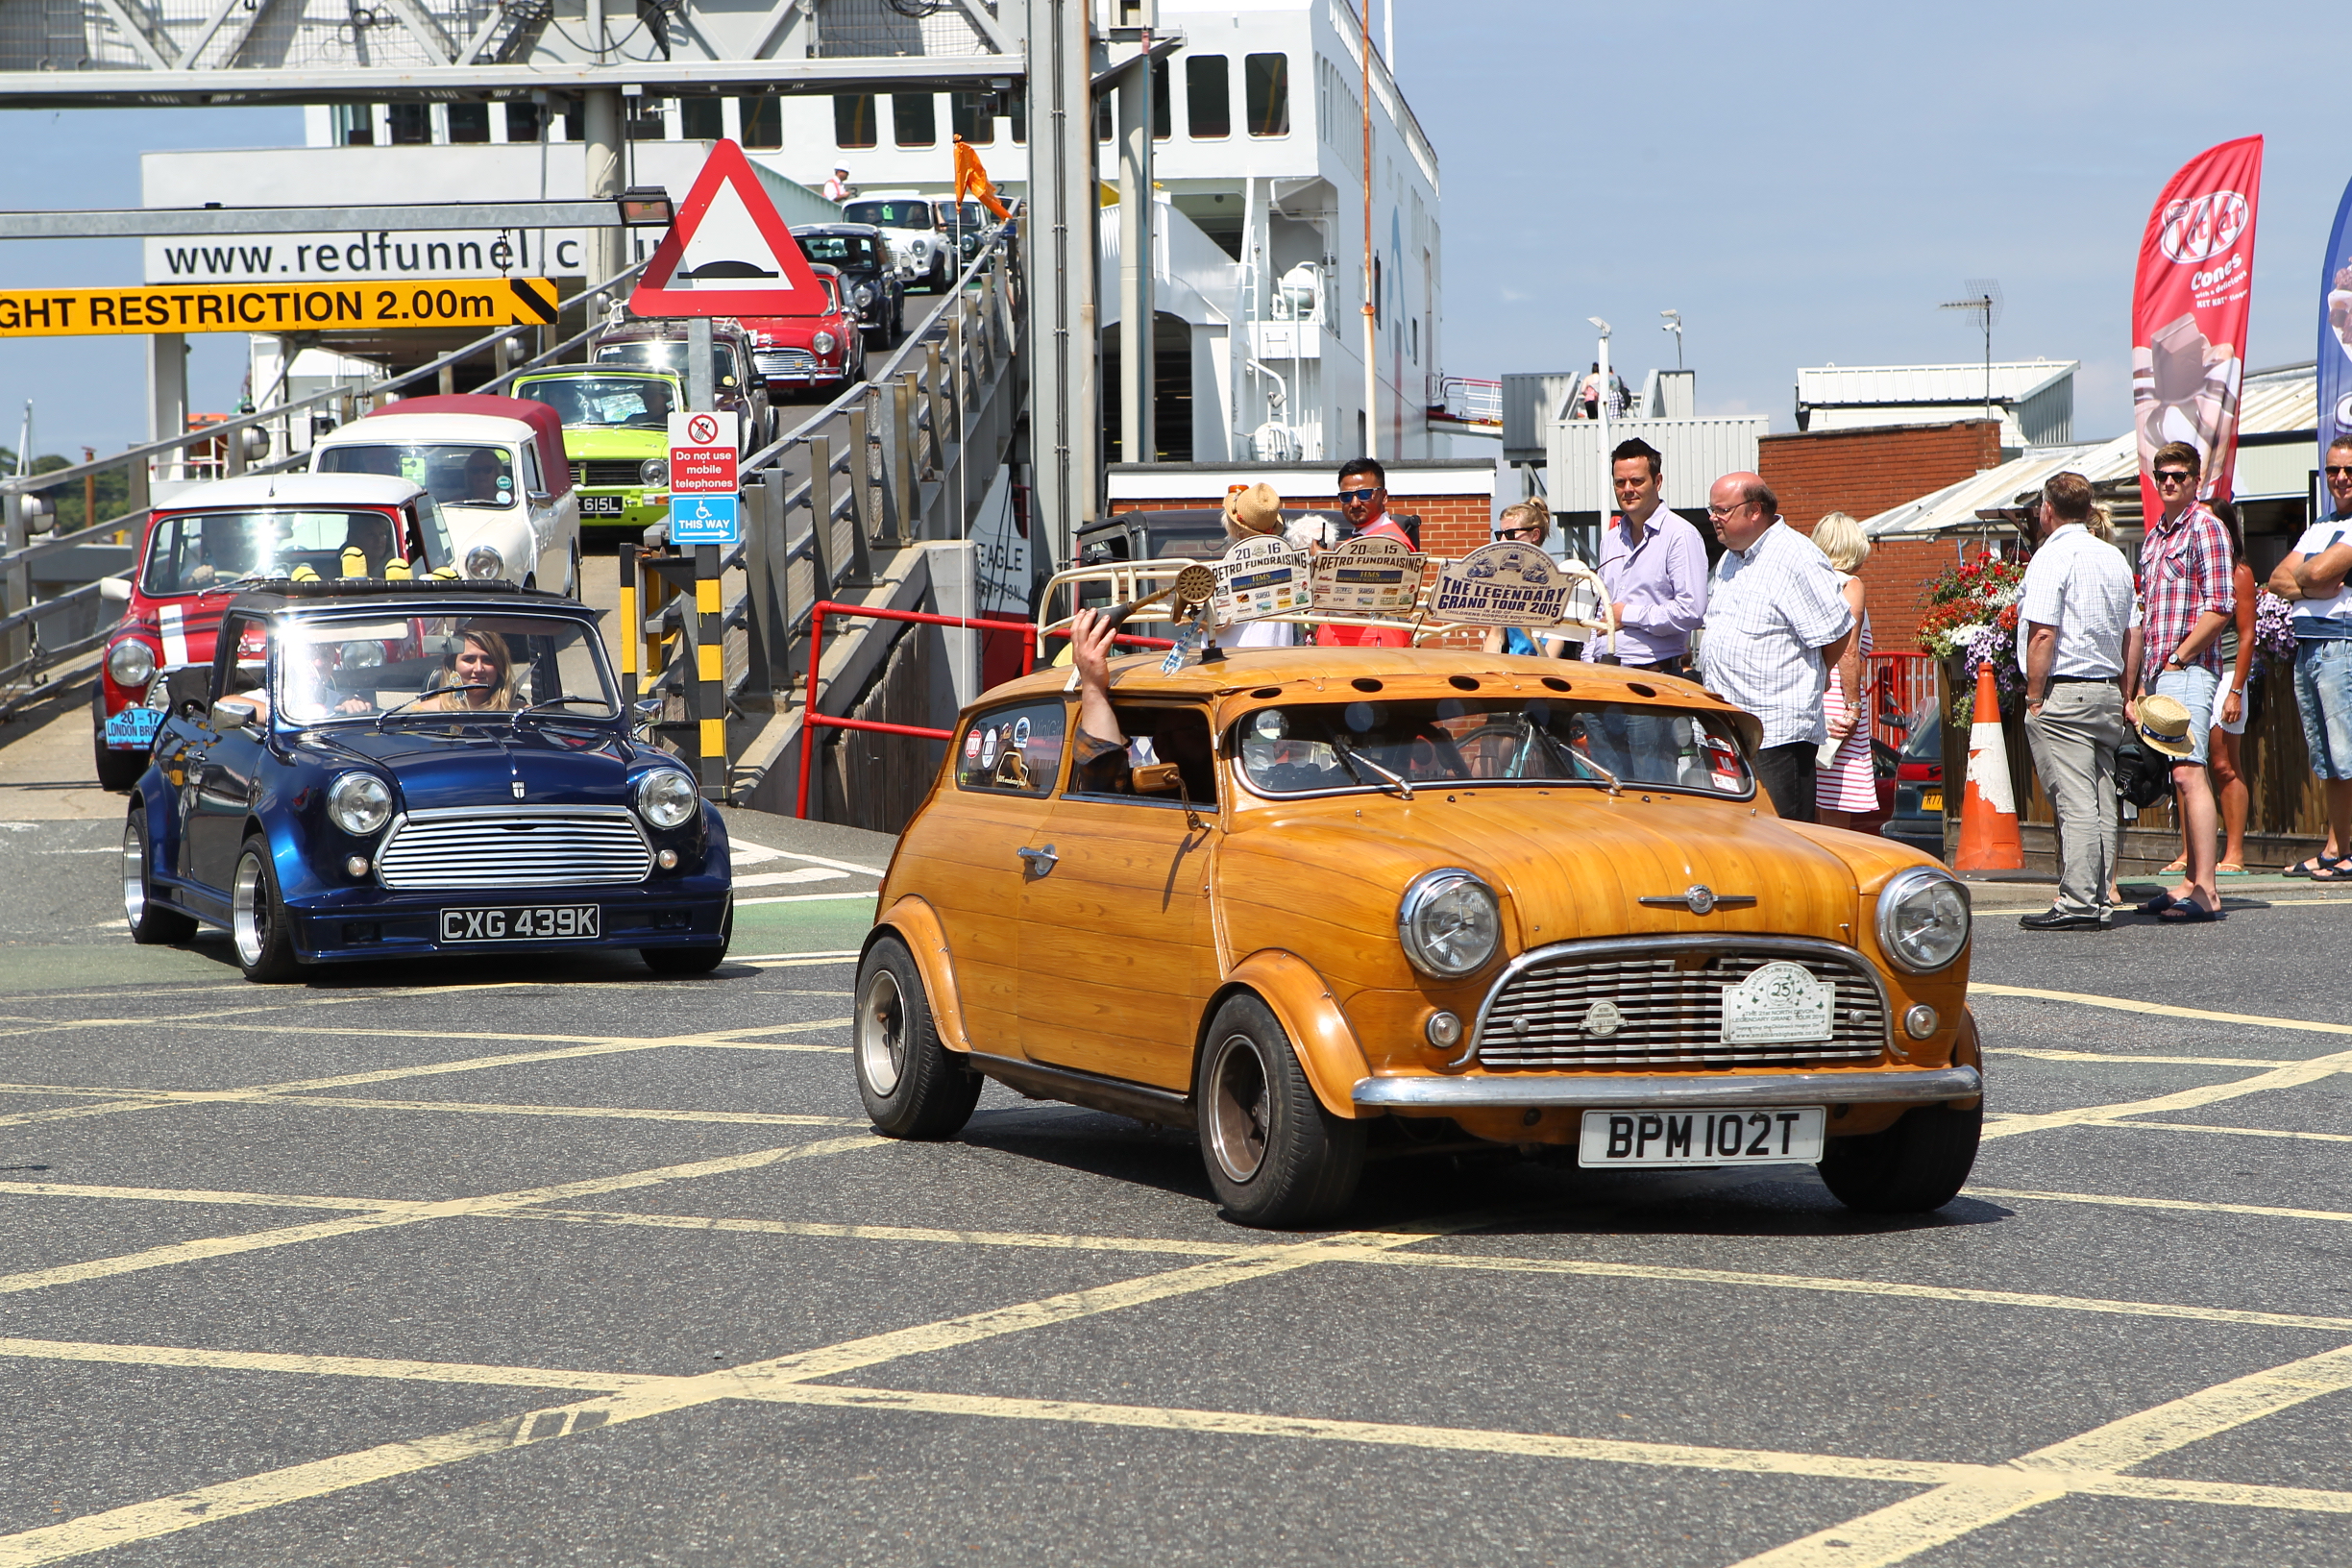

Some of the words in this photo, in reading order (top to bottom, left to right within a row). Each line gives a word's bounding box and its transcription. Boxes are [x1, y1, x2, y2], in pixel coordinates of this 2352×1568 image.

[2191, 253, 2242, 291] Cones
[89, 290, 362, 327] RESTRICTION
[376, 289, 494, 320] 2.00m
[2196, 299, 2211, 308] KIT
[675, 451, 691, 461] Do
[693, 452, 710, 461] not
[713, 452, 732, 461] use
[686, 465, 722, 475] mobile
[675, 479, 733, 490] telephones
[583, 498, 619, 511] 615L
[678, 520, 702, 529] THIS
[705, 520, 731, 529] WAY
[1236, 548, 1250, 561] 20
[1267, 542, 1281, 555] 16
[1349, 544, 1367, 555] 20
[1384, 544, 1398, 554] 15
[977, 543, 1023, 572] EAGLE
[1318, 556, 1354, 573] RETRO
[1357, 556, 1422, 574] FUNDRAISING
[1212, 562, 1242, 584] RETRO
[1245, 551, 1308, 569] FUNDRAISING
[1252, 573, 1271, 583] HMS
[1441, 576, 1472, 596] THE
[1475, 585, 1568, 603] LEGENDARY
[1437, 594, 1487, 610] GRAND
[1491, 599, 1527, 612] TOUR
[1529, 601, 1562, 618] 2015
[120, 711, 135, 724] 20
[147, 712, 160, 724] 17
[107, 723, 137, 738] LONDON
[443, 911, 506, 939] CXG
[514, 908, 596, 936] 439K
[1771, 982, 1792, 997] 25
[1606, 1115, 1693, 1159] BPM
[1704, 1113, 1800, 1157] 102T
